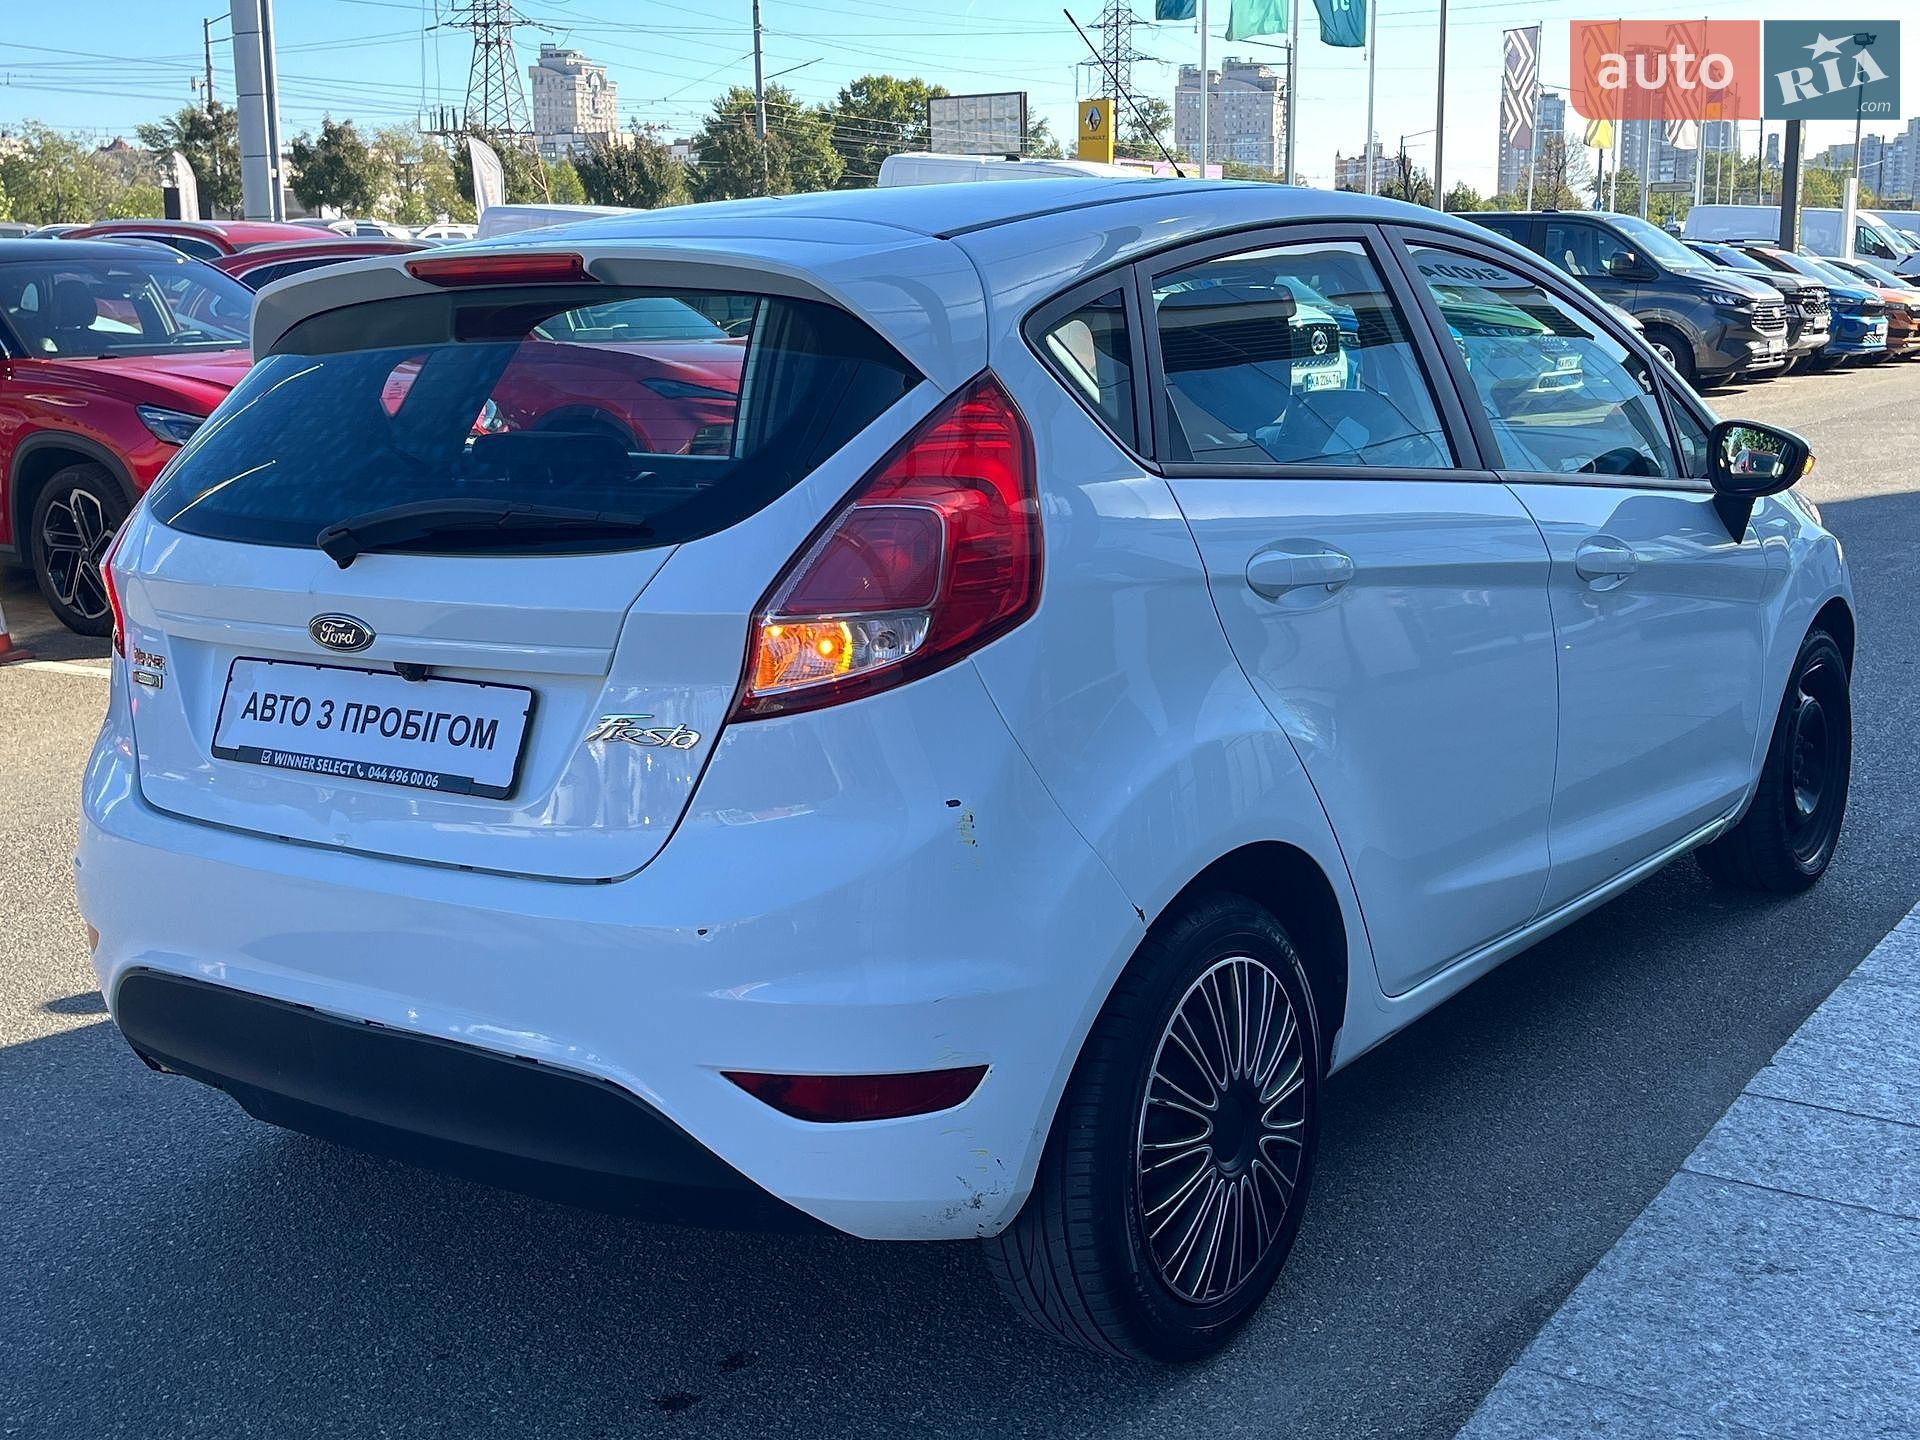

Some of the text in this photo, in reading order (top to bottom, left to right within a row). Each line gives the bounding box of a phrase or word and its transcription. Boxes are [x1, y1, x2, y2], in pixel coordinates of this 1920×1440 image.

[319, 621, 357, 645] Ford
[240, 691, 312, 727] АВТО
[340, 702, 499, 751] ПРОБІГОМ
[583, 713, 702, 750] Fiesta
[274, 752, 439, 789] WINNER SELECT 044 496 00 06
